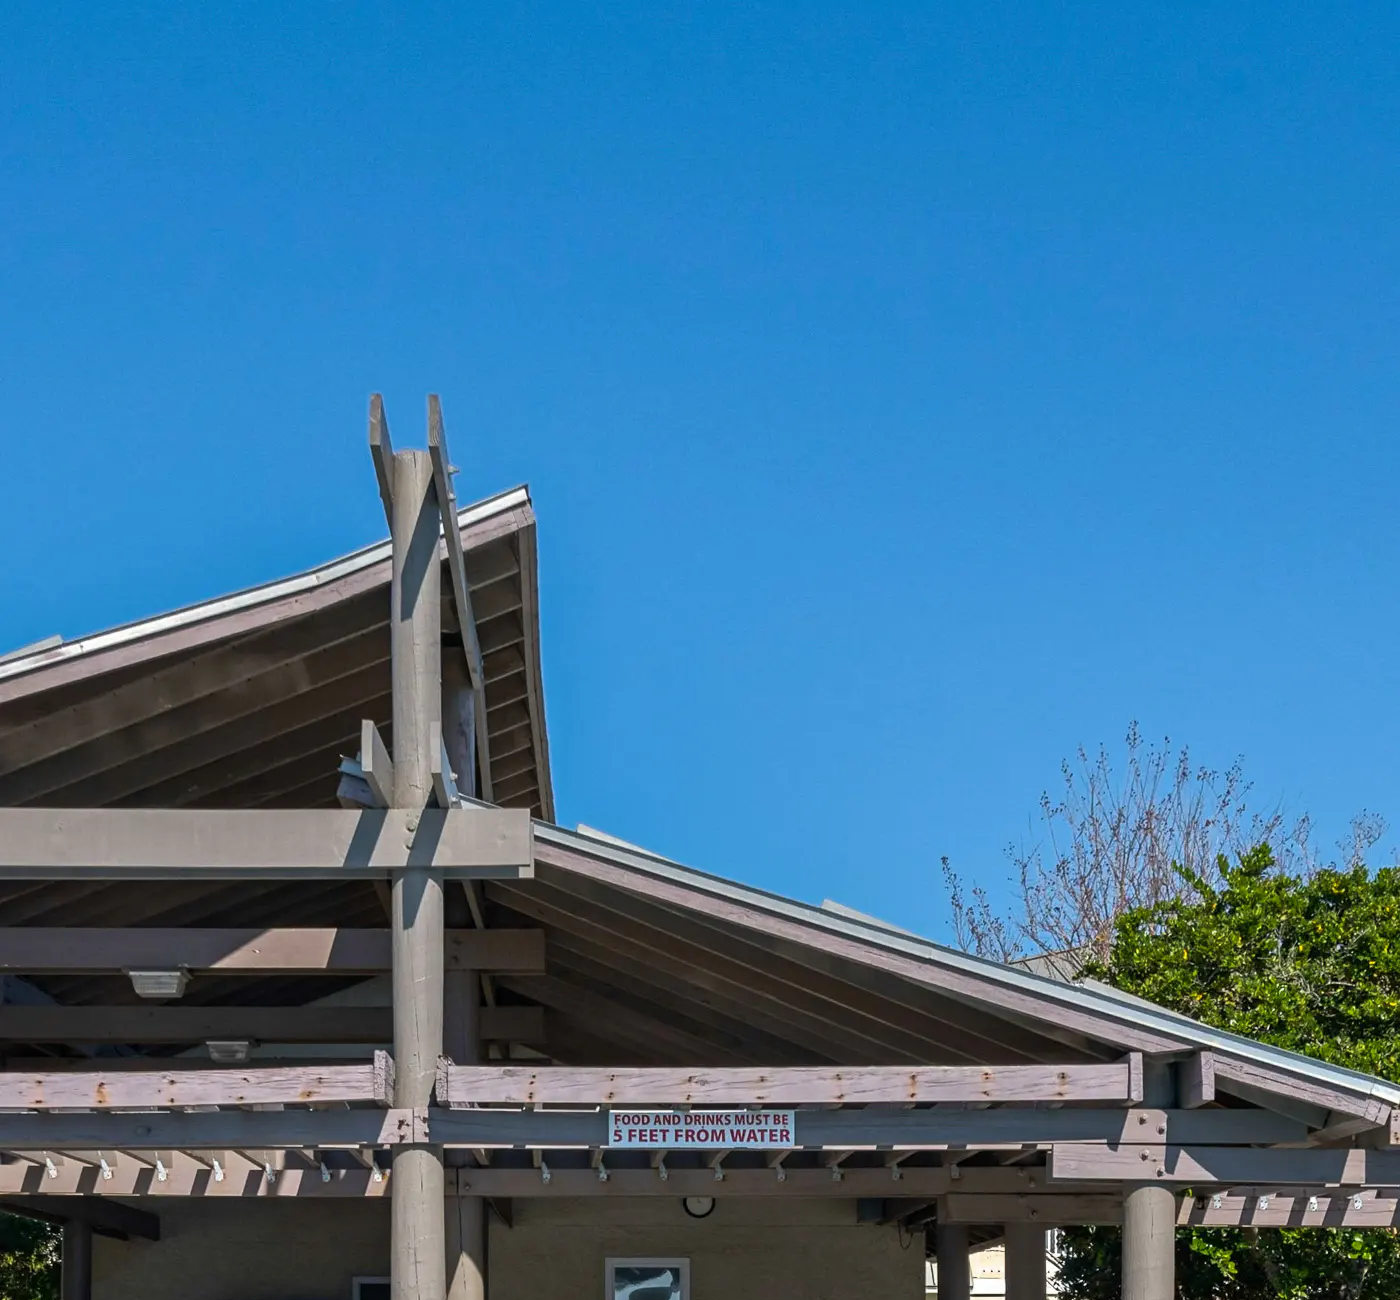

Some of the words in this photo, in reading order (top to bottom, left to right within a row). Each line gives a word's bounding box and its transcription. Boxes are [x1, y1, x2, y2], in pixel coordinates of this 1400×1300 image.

[615, 1114, 650, 1125] FOOD
[654, 1114, 681, 1125] AND
[685, 1114, 732, 1125] DRINKS
[734, 1114, 770, 1125] MUST
[773, 1114, 789, 1125] BE
[613, 1129, 622, 1142] 5
[628, 1129, 669, 1142] FEET
[674, 1129, 725, 1142] FROM
[730, 1129, 790, 1142] WATER
